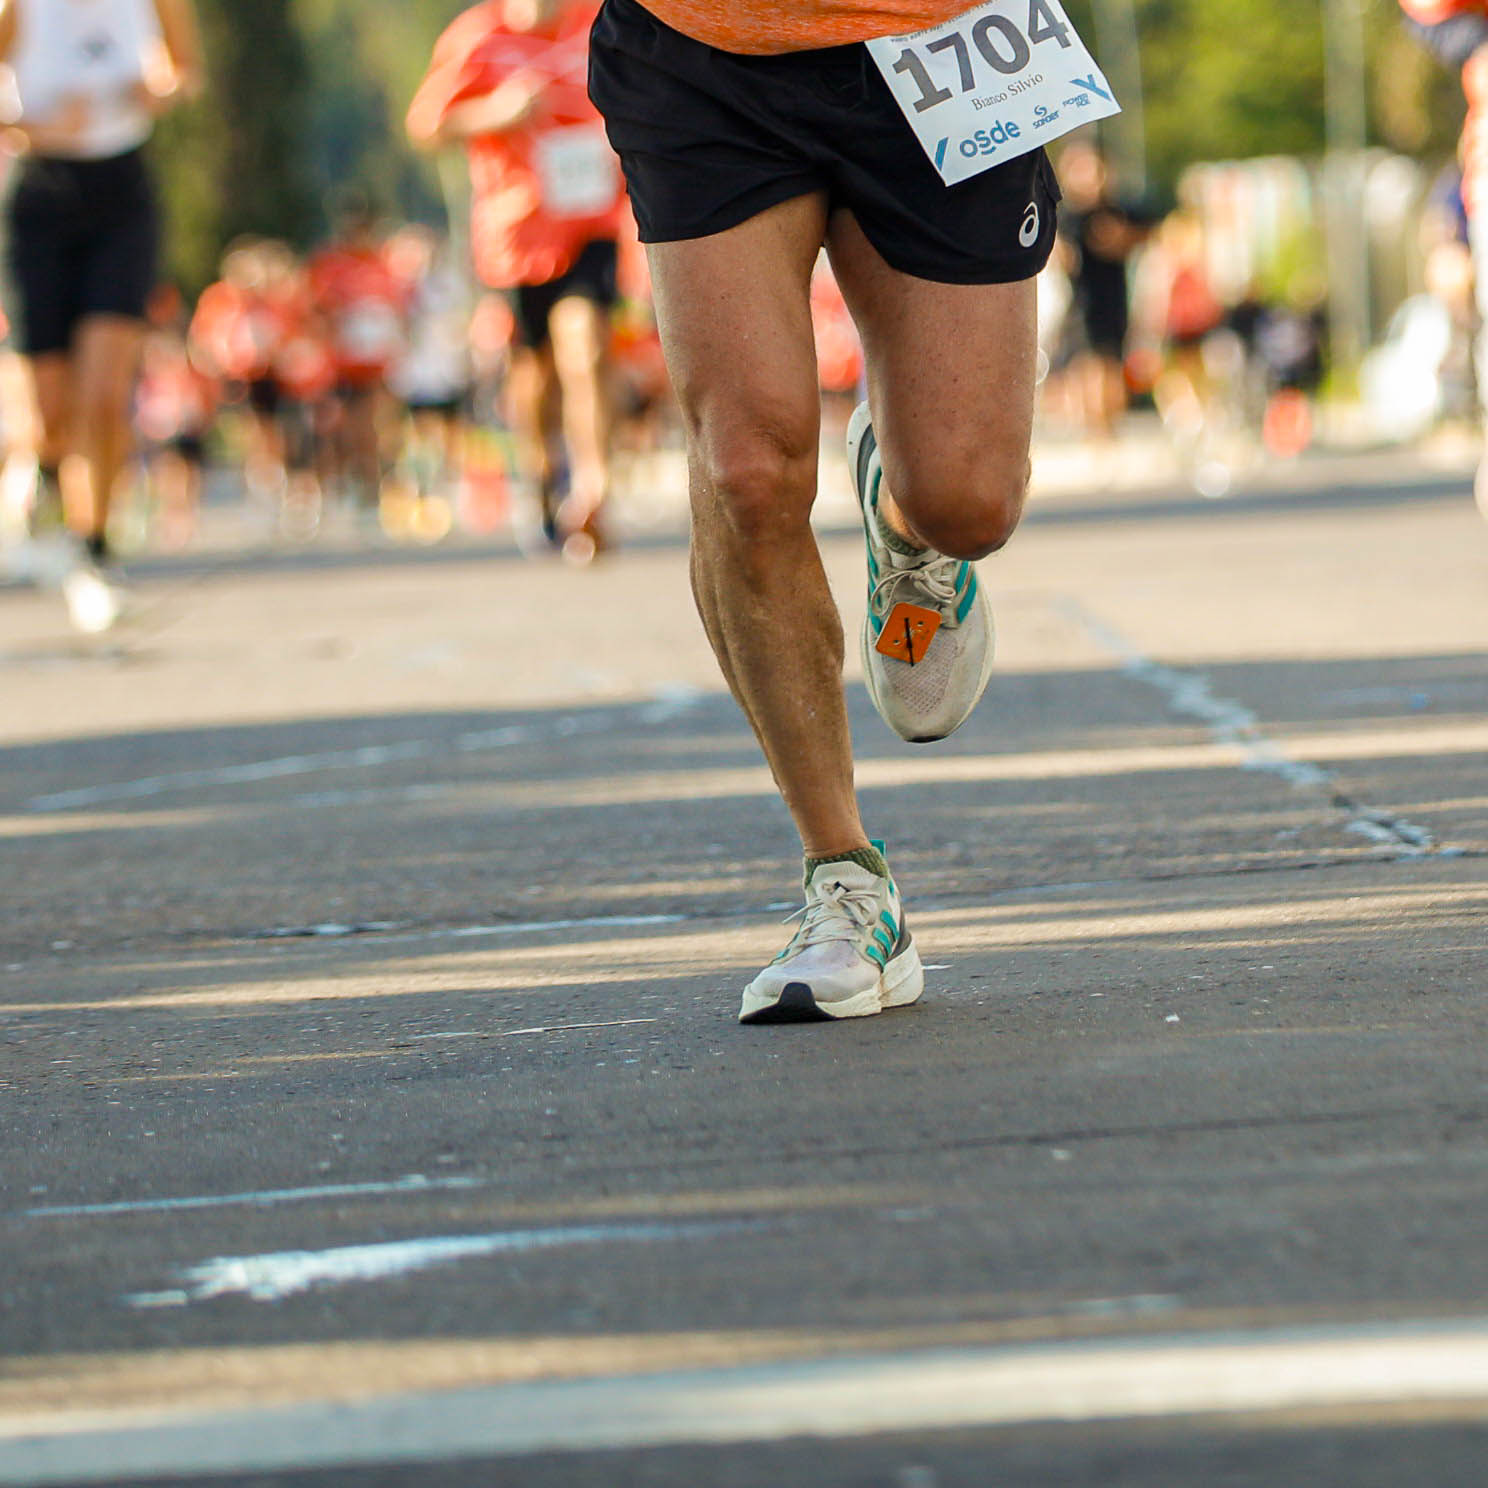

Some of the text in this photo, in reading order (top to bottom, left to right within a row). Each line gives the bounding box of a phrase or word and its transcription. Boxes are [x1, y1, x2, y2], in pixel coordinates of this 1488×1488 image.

[971, 73, 1044, 111] Bianco Silvio
[959, 120, 1021, 158] osde
